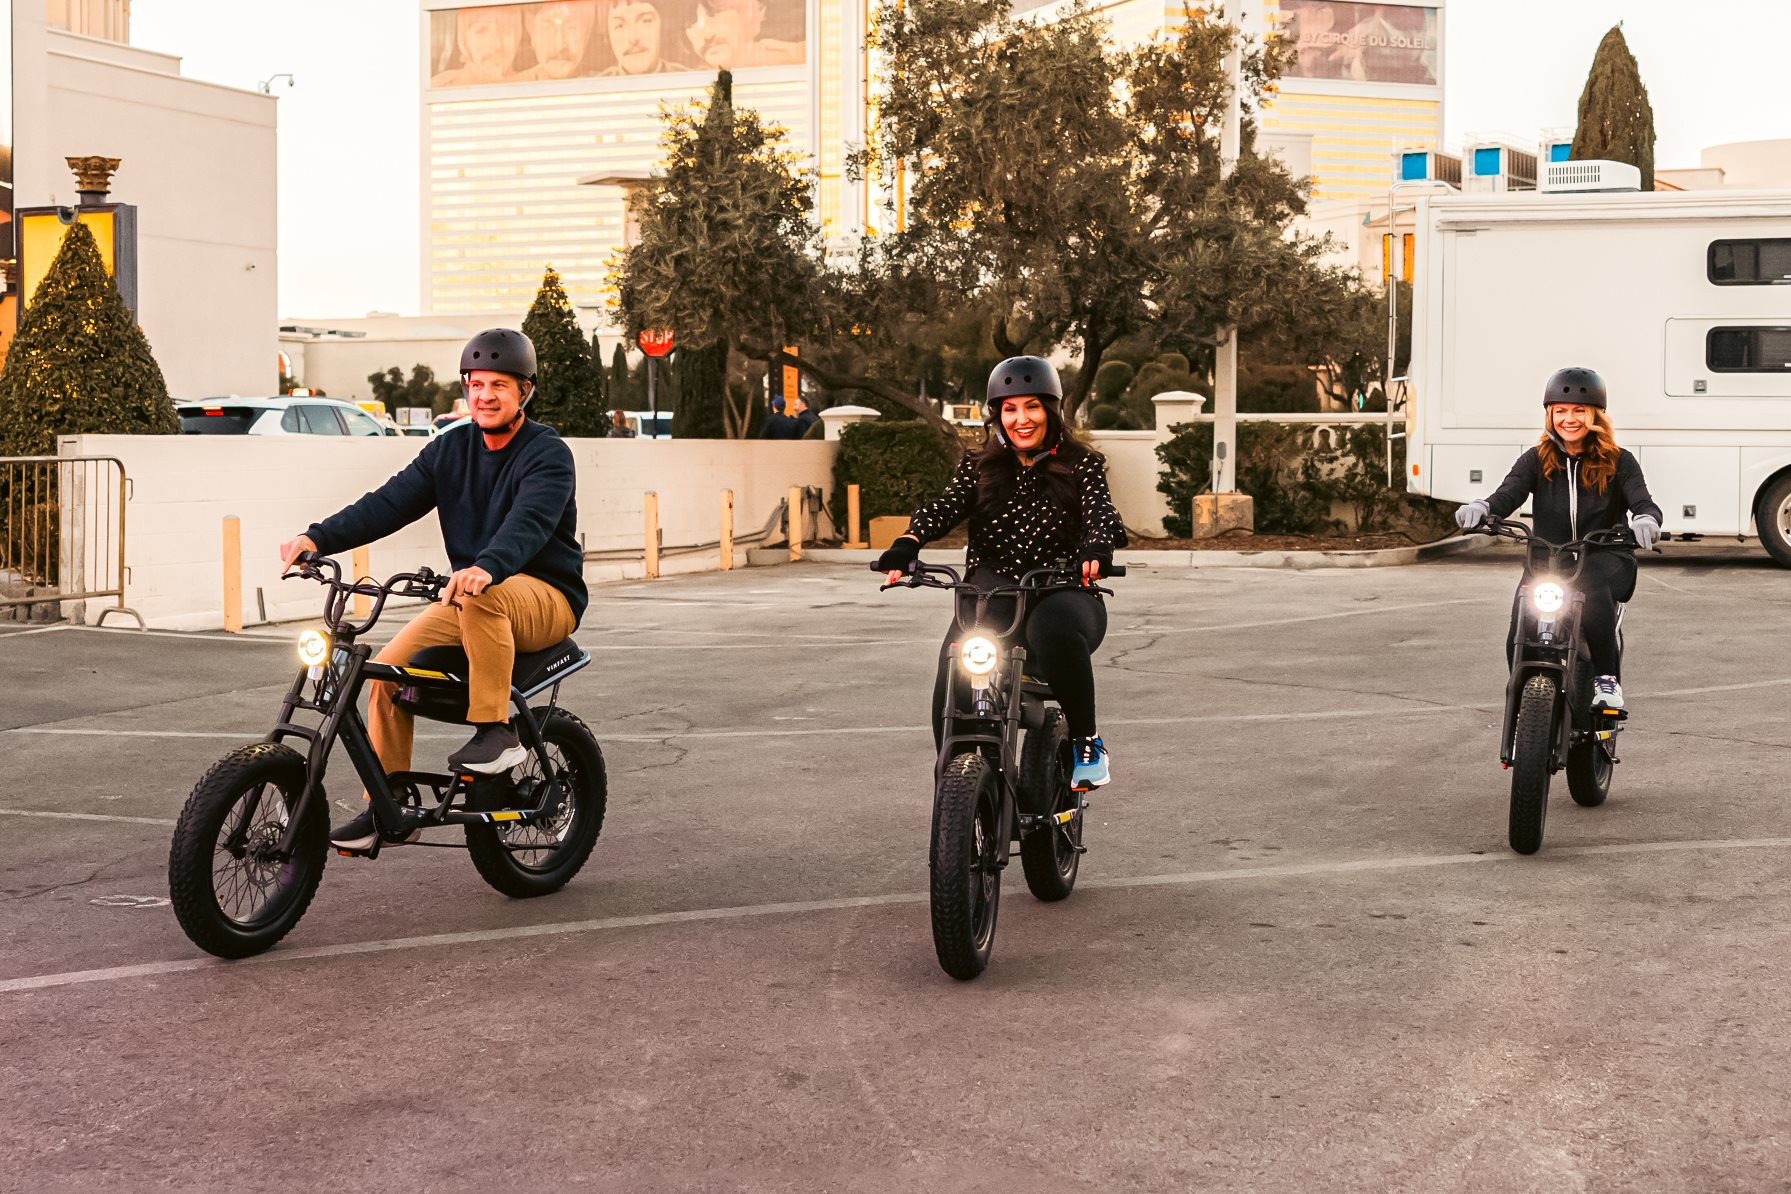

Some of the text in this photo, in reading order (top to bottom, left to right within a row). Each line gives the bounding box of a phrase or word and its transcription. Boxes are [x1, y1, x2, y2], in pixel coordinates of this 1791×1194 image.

[1304, 32, 1431, 49] BY CIRQUE DU SOLEIL
[546, 654, 570, 672] VINFAST
